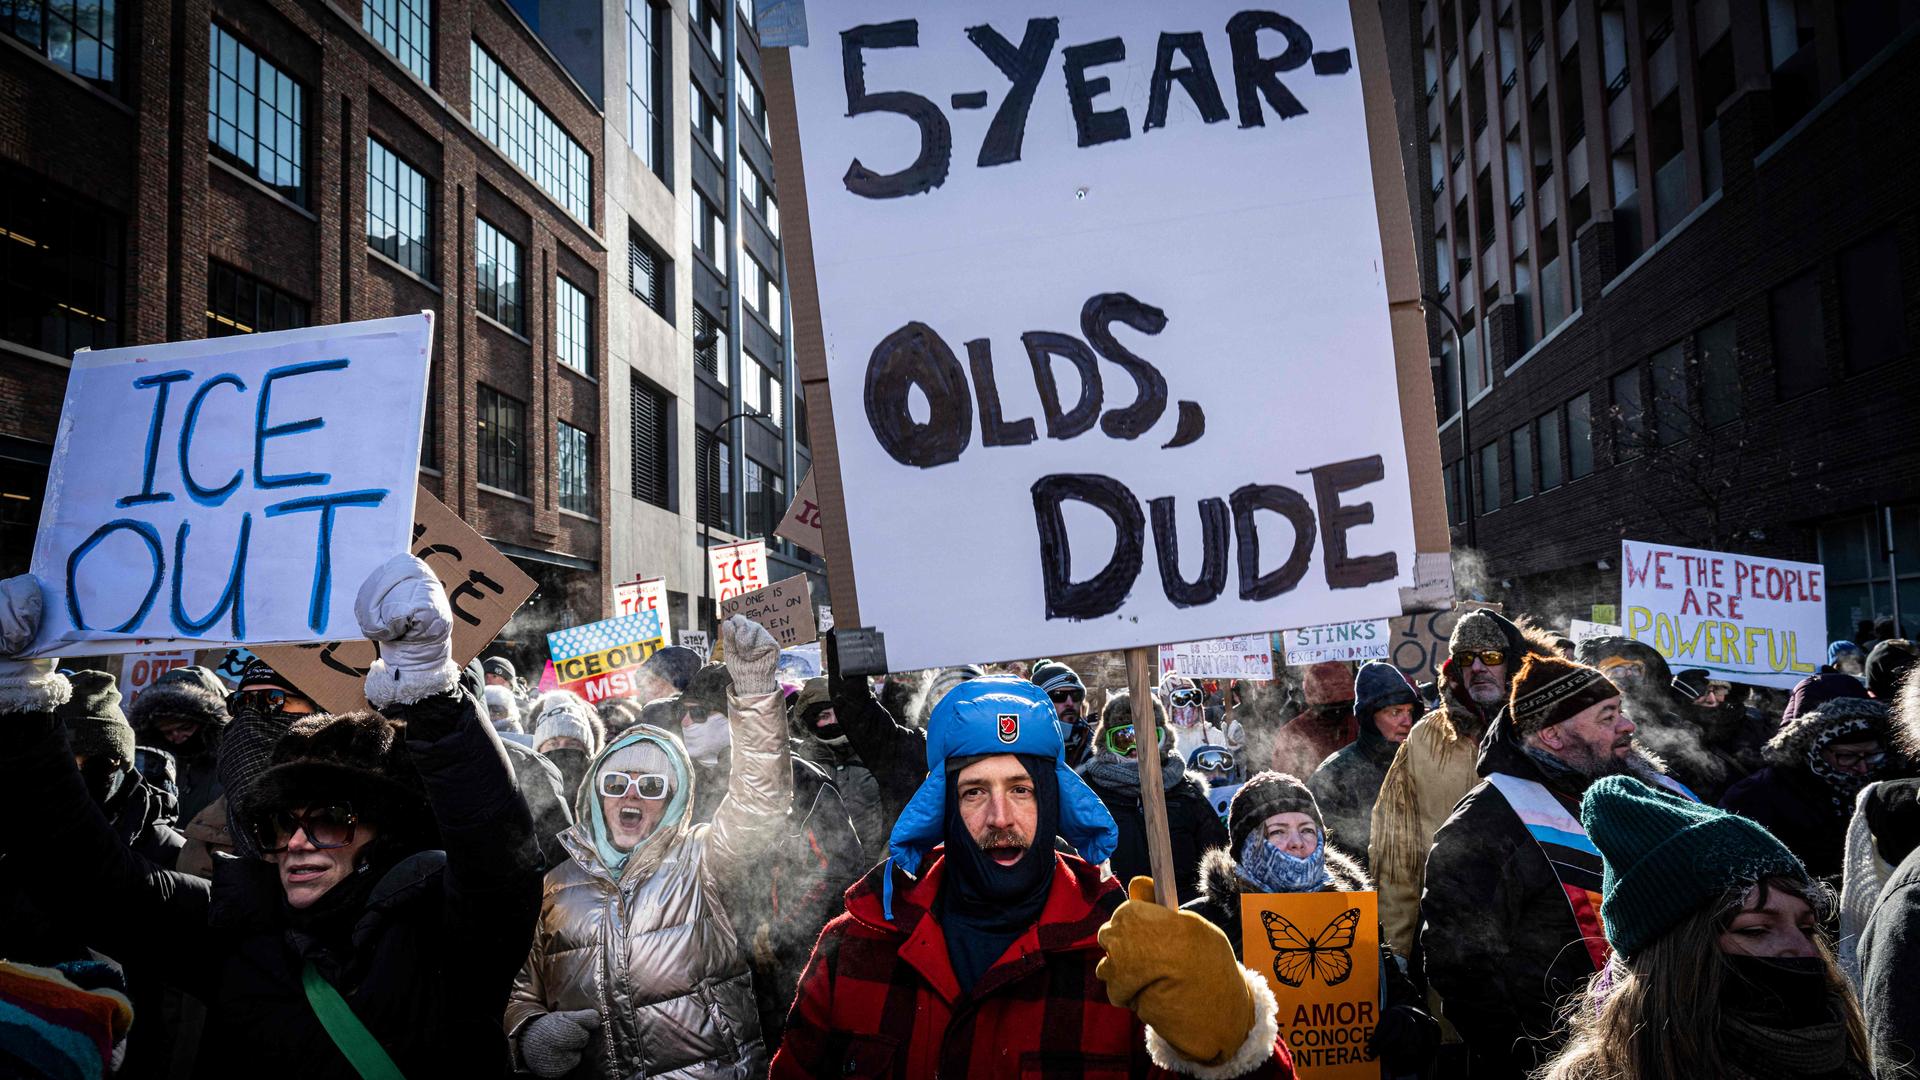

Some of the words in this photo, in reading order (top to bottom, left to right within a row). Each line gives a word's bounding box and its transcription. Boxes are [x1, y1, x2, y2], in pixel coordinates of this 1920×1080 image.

[840, 9, 1351, 200] 5-YEAR-
[864, 292, 1205, 468] OLDS,
[116, 358, 351, 506] ICE
[1031, 454, 1398, 620] DUDE
[66, 489, 390, 640] OUT
[718, 558, 758, 584] ICE
[1624, 544, 1673, 589] WE
[1676, 555, 1725, 588] THE
[1735, 559, 1822, 603] PEOPLE
[721, 601, 739, 616] NO
[745, 592, 765, 606] ONE
[773, 587, 782, 598] IS
[786, 596, 802, 608] ON
[1679, 587, 1744, 620] ARE
[760, 616, 790, 630] LEN
[1297, 623, 1376, 646] STINKS
[684, 635, 704, 646] STAY
[1287, 649, 1327, 665] (EXCEPT
[1333, 649, 1344, 660] IN
[1348, 643, 1388, 659] DRINKS)
[1628, 605, 1816, 673] POWERFUL
[555, 654, 601, 682] ICE
[607, 639, 661, 669] OUT
[1292, 1001, 1373, 1027] AMOR
[1290, 1026, 1375, 1047] CONOCE
